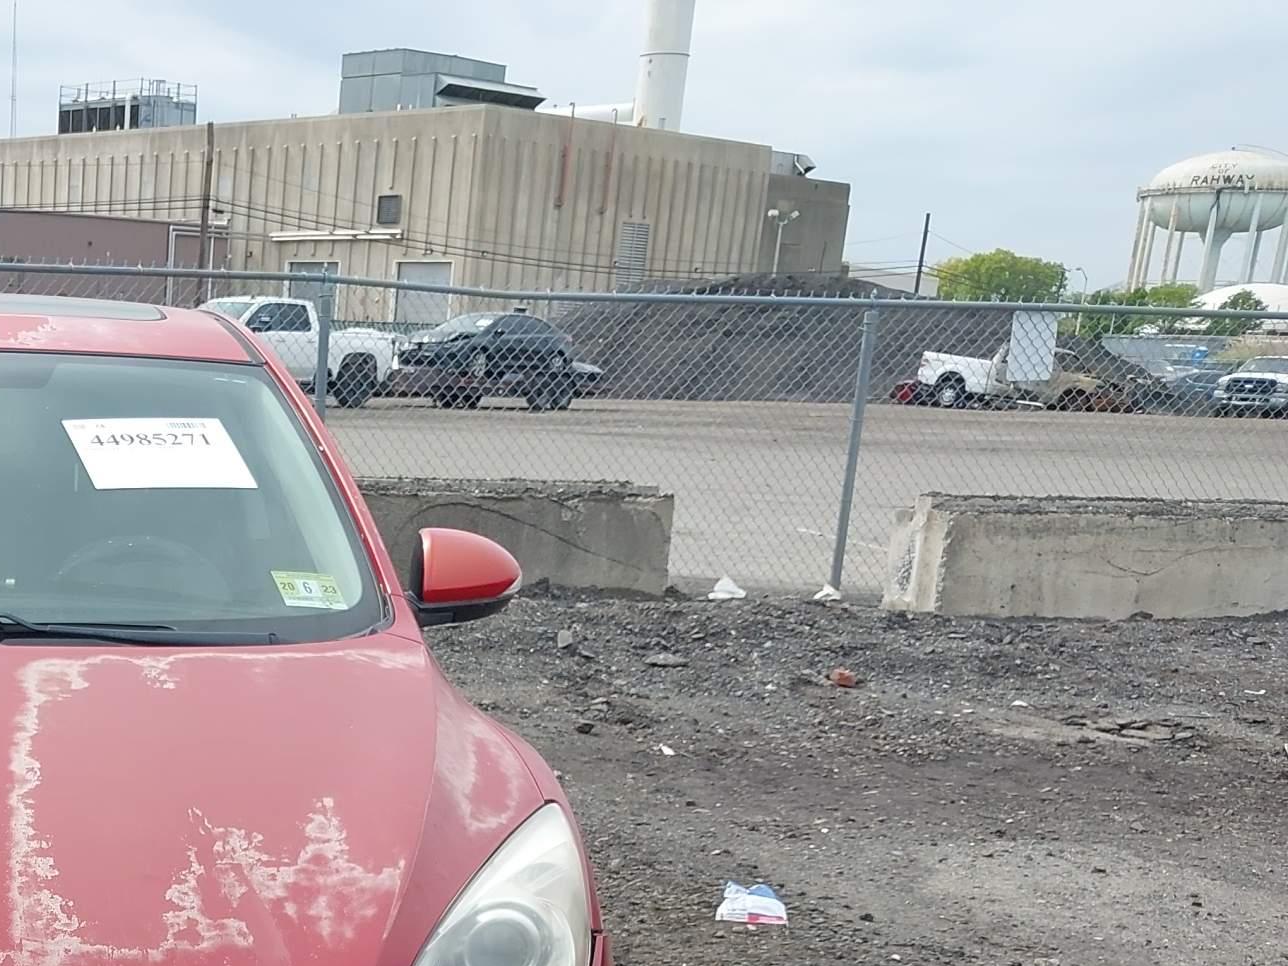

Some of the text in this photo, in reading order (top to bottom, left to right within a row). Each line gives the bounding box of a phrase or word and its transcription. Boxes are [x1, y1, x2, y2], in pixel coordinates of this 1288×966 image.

[1190, 174, 1256, 185] RAHWAY
[90, 432, 211, 446] 44985271
[280, 581, 337, 595] 20 6 23
